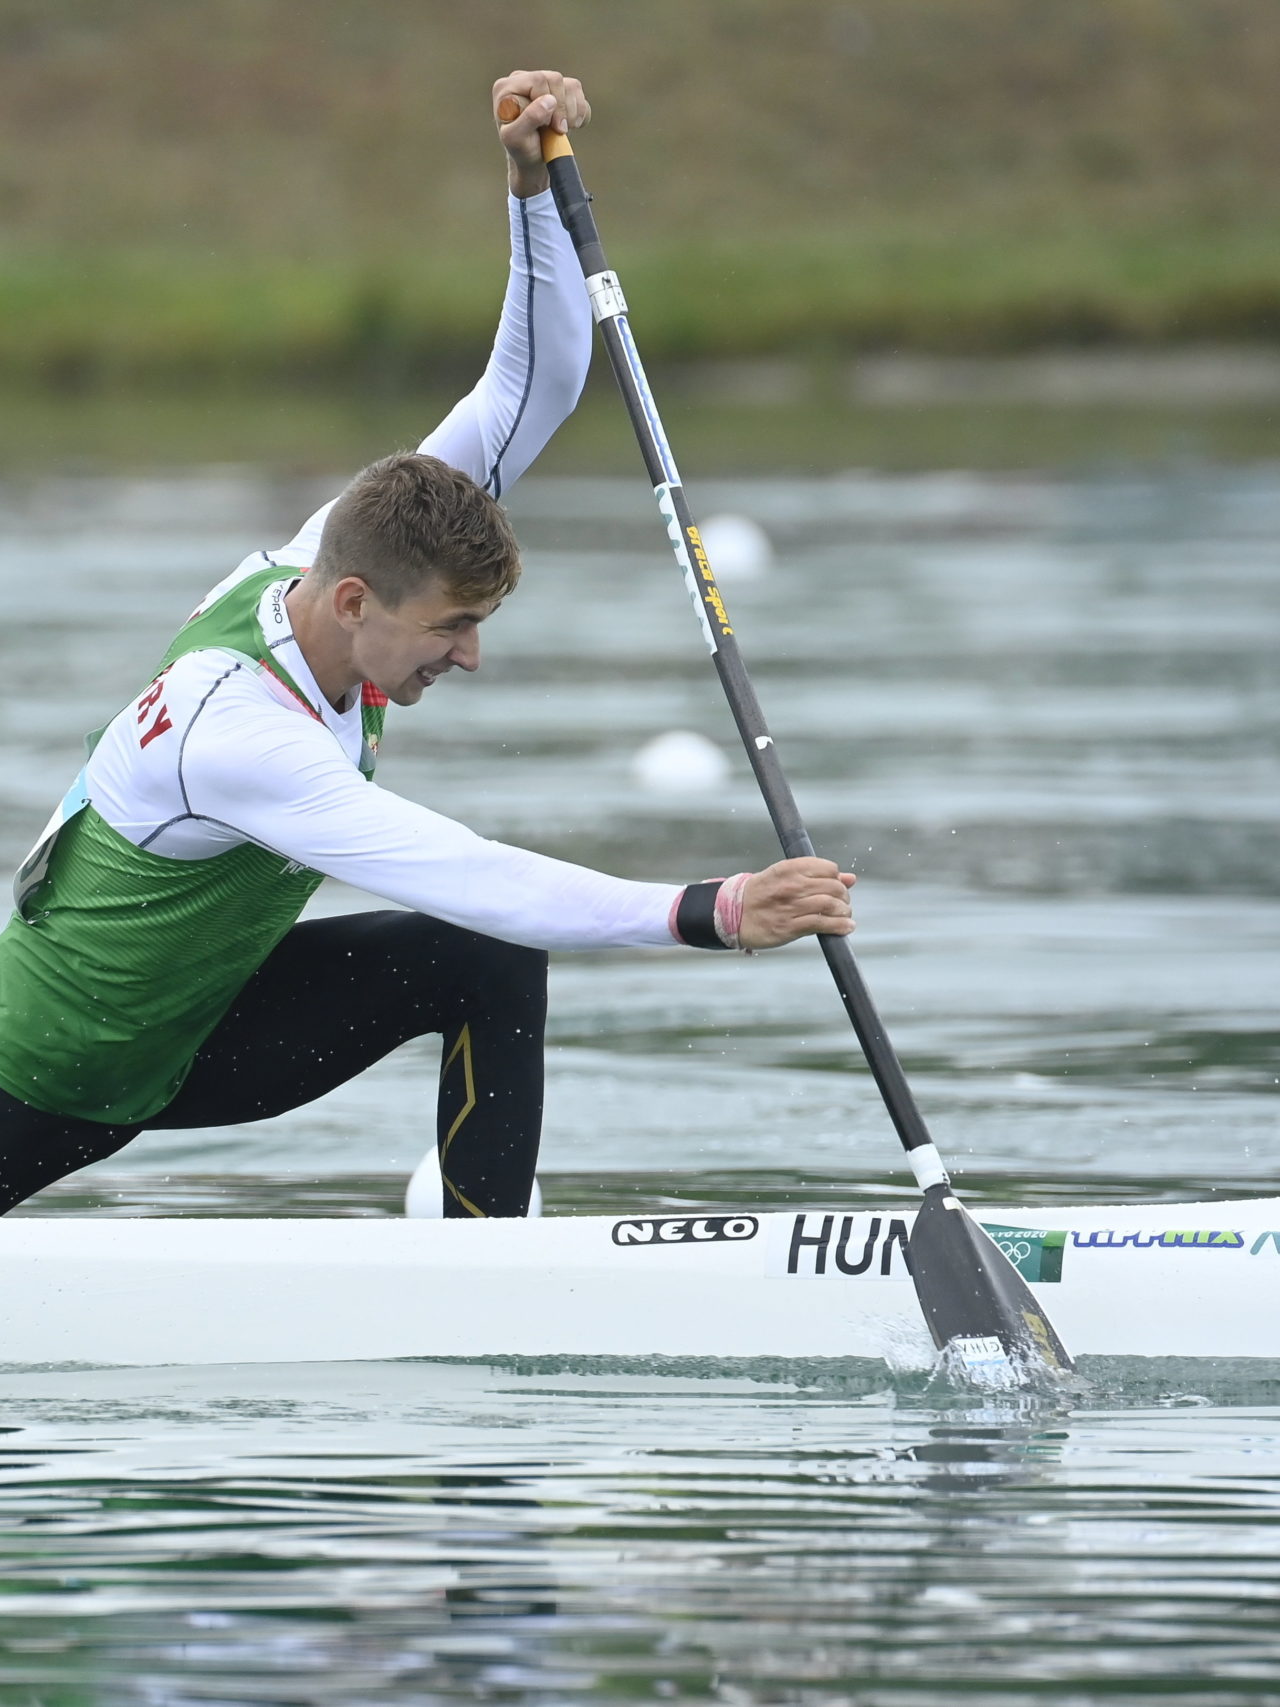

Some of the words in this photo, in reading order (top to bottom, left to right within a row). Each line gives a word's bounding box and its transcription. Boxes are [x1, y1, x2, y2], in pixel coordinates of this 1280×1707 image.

[272, 585, 284, 624] EPRO
[616, 1217, 756, 1244] NELO
[787, 1214, 915, 1276] HUN
